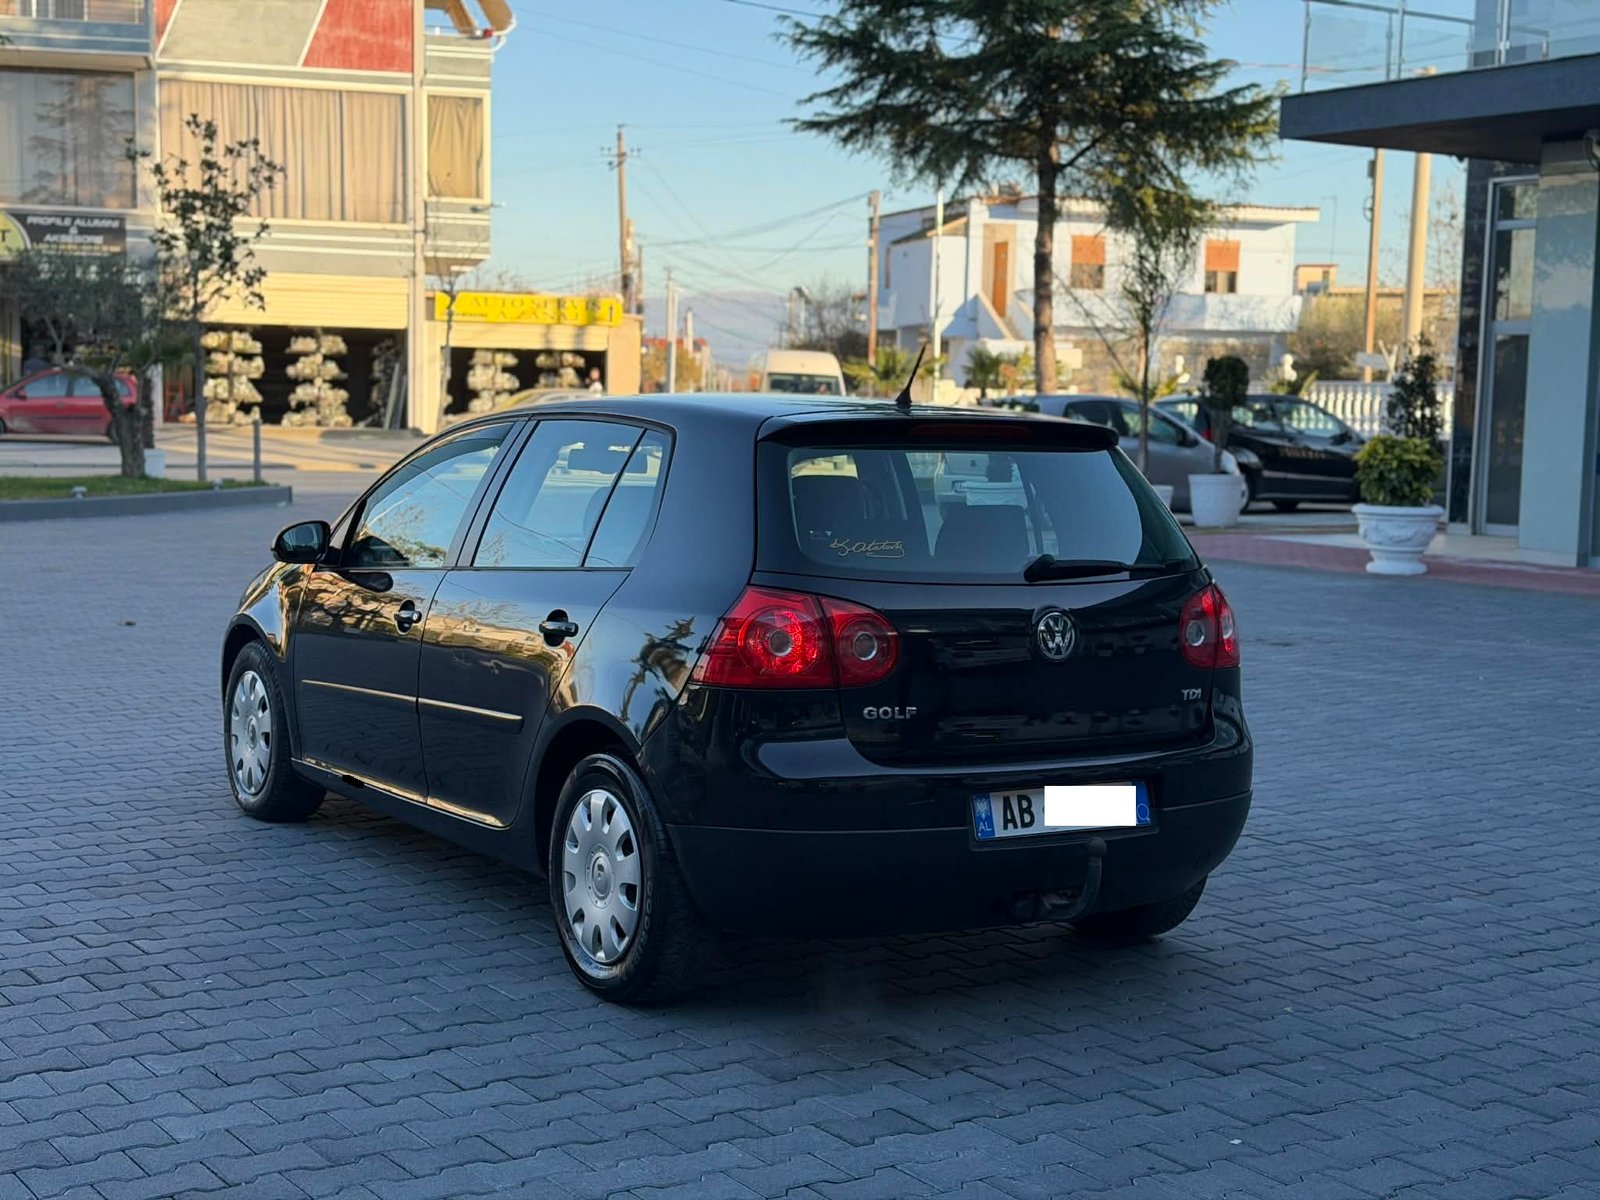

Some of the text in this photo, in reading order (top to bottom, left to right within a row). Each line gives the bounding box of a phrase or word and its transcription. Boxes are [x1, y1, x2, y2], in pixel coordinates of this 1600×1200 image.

[26, 216, 73, 226] PROFILE
[1181, 687, 1202, 701] TDI
[863, 706, 917, 720] GOLF
[1002, 795, 1035, 830] AB
[978, 822, 992, 832] AL
